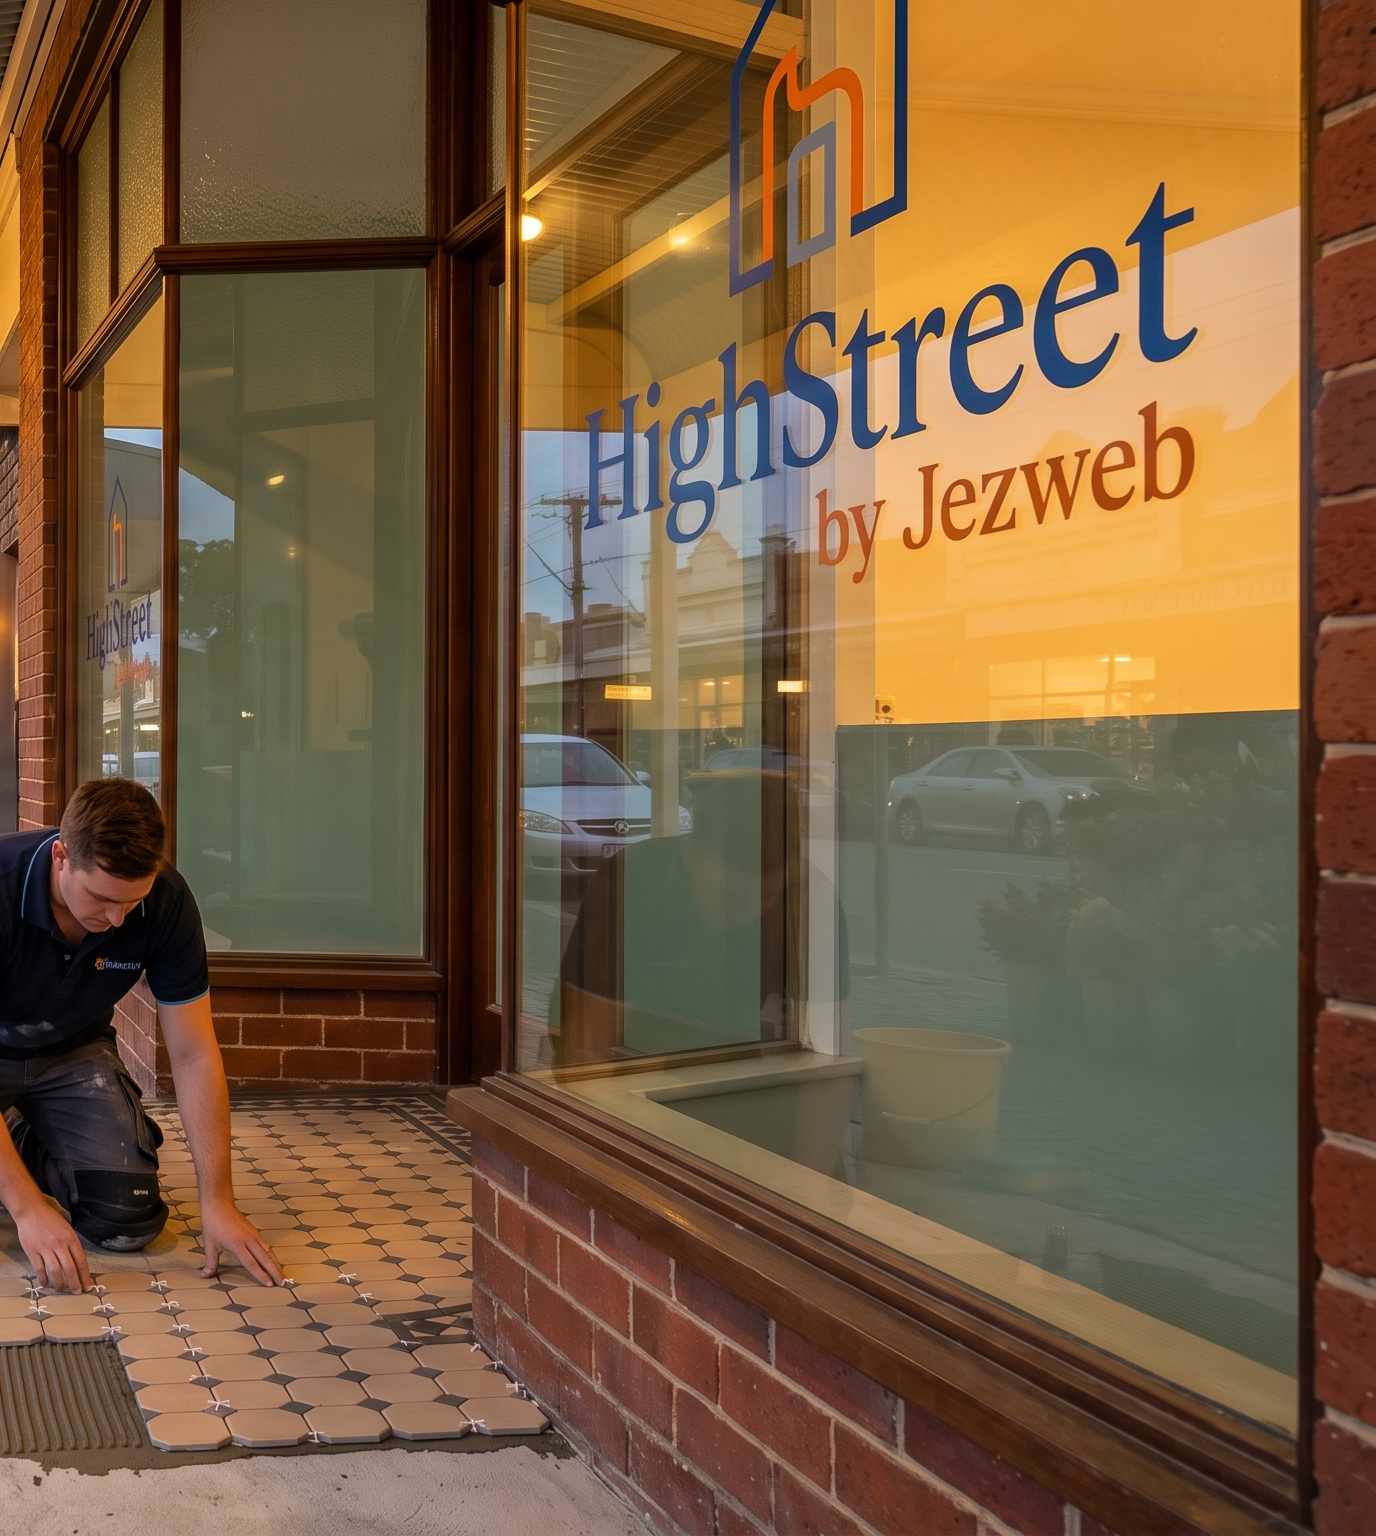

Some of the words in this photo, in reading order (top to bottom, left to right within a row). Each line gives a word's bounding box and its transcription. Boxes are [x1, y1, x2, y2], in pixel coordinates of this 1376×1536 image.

[584, 182, 1198, 544] HighStreet
[815, 488, 886, 584] by
[903, 401, 1195, 550] Jezweb
[86, 590, 152, 671] HighStreet
